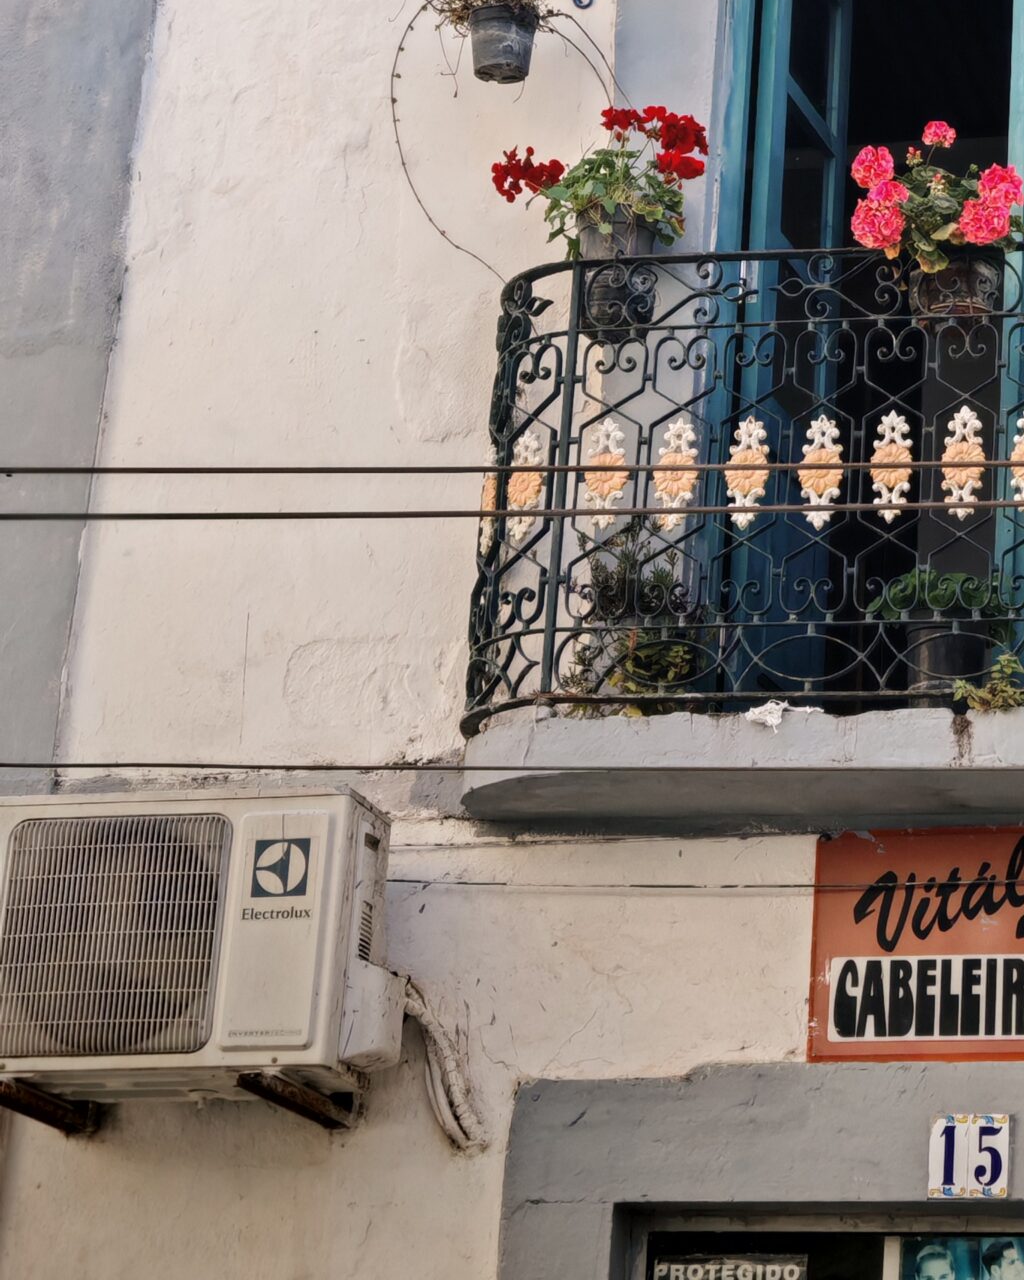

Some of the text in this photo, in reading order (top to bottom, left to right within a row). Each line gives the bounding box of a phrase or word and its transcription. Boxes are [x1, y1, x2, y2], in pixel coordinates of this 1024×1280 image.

[241, 906, 312, 921] Electrolux
[940, 1125, 1003, 1187] 15
[653, 1264, 801, 1280] PROTEGIDO
